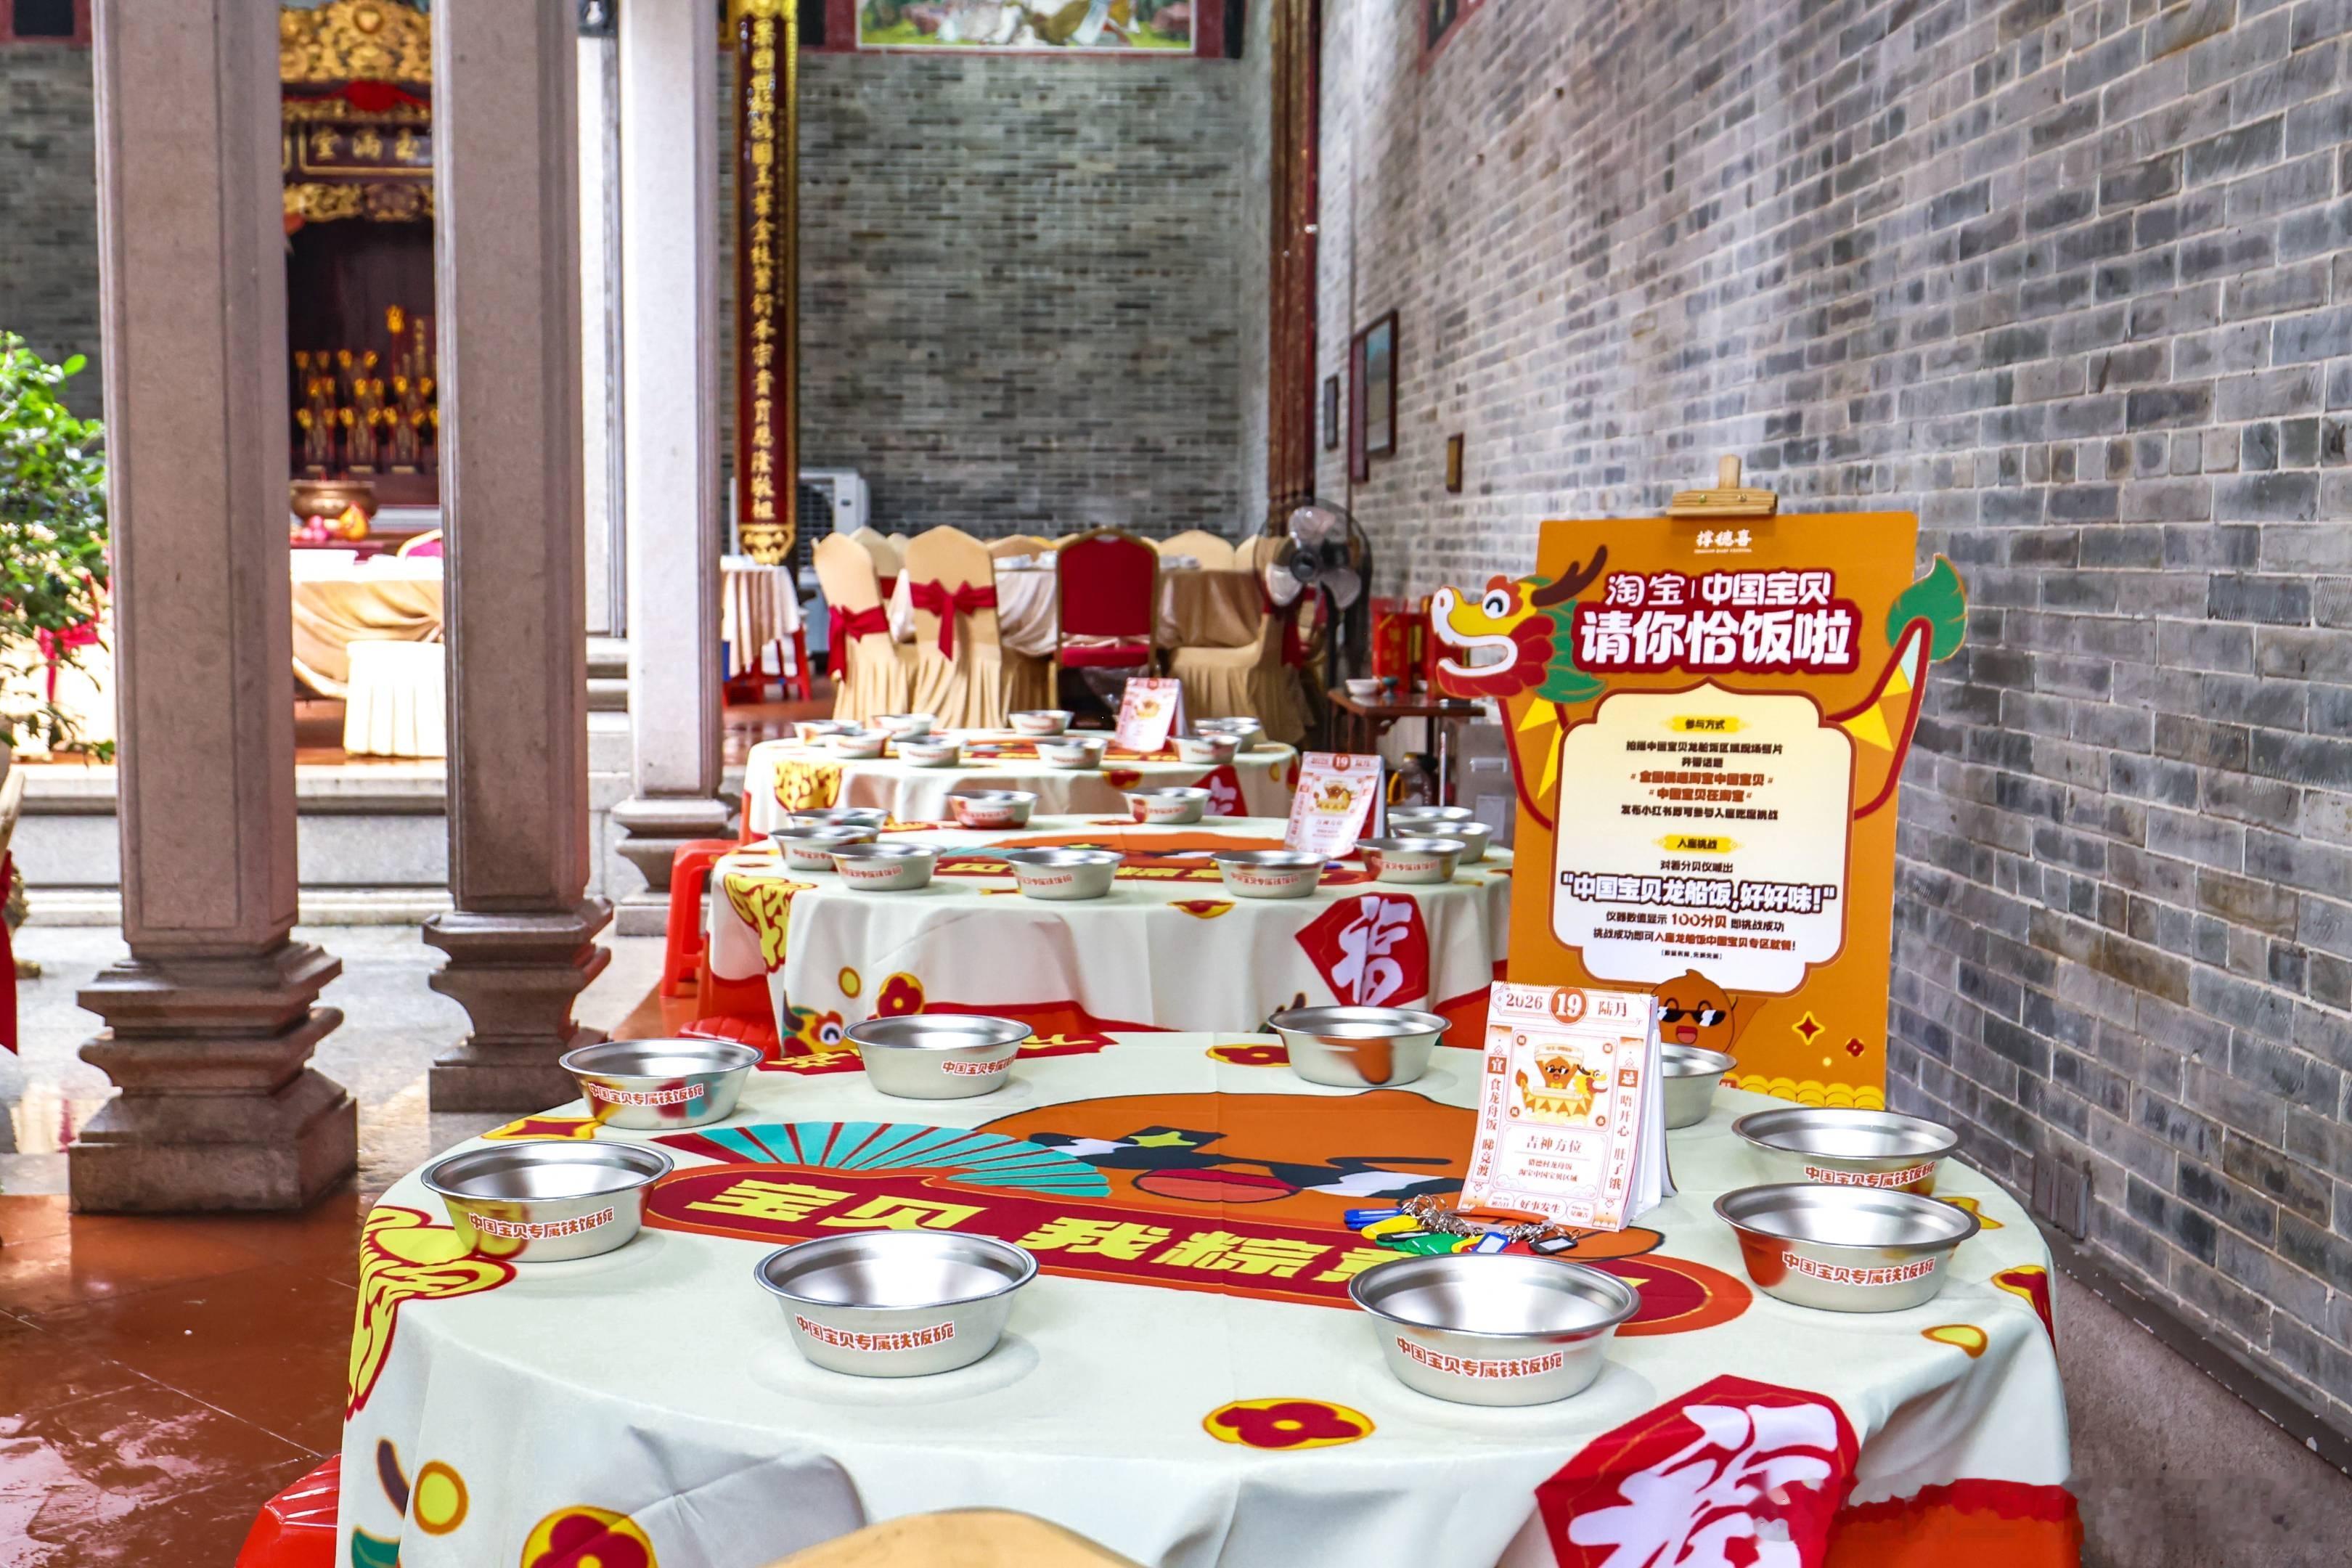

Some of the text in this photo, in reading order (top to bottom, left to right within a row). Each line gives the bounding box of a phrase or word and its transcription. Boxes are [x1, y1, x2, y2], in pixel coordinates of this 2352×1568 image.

[1605, 572, 1831, 606] 淘宝 中国宝贝
[1580, 609, 1852, 666] 请你恰饭啦
[1685, 719, 1725, 730] 参与方式
[1671, 912, 1728, 930] 100分贝
[1731, 918, 1785, 933] 即挑战成功
[1331, 895, 1413, 1007] 福
[1506, 992, 1583, 1018] 2026 19
[1598, 1000, 1628, 1018] 陆月
[587, 1082, 704, 1106] 中国宝贝专属铁饭碗
[1486, 1078, 1501, 1130] 食龙舟饭
[1526, 1135, 1583, 1153] 吉神方位
[1609, 1148, 1626, 1191] 肚子饿
[469, 1206, 616, 1240] 中国宝贝专属铁饭碗
[1520, 1199, 1561, 1214] 好事发生
[1782, 1252, 1937, 1286] 中国宝贝专属铁饭碗
[795, 1313, 955, 1352] 中国宝贝专属铁饭碗
[1395, 1336, 1564, 1379] 中国宝贝专属铁饭碗
